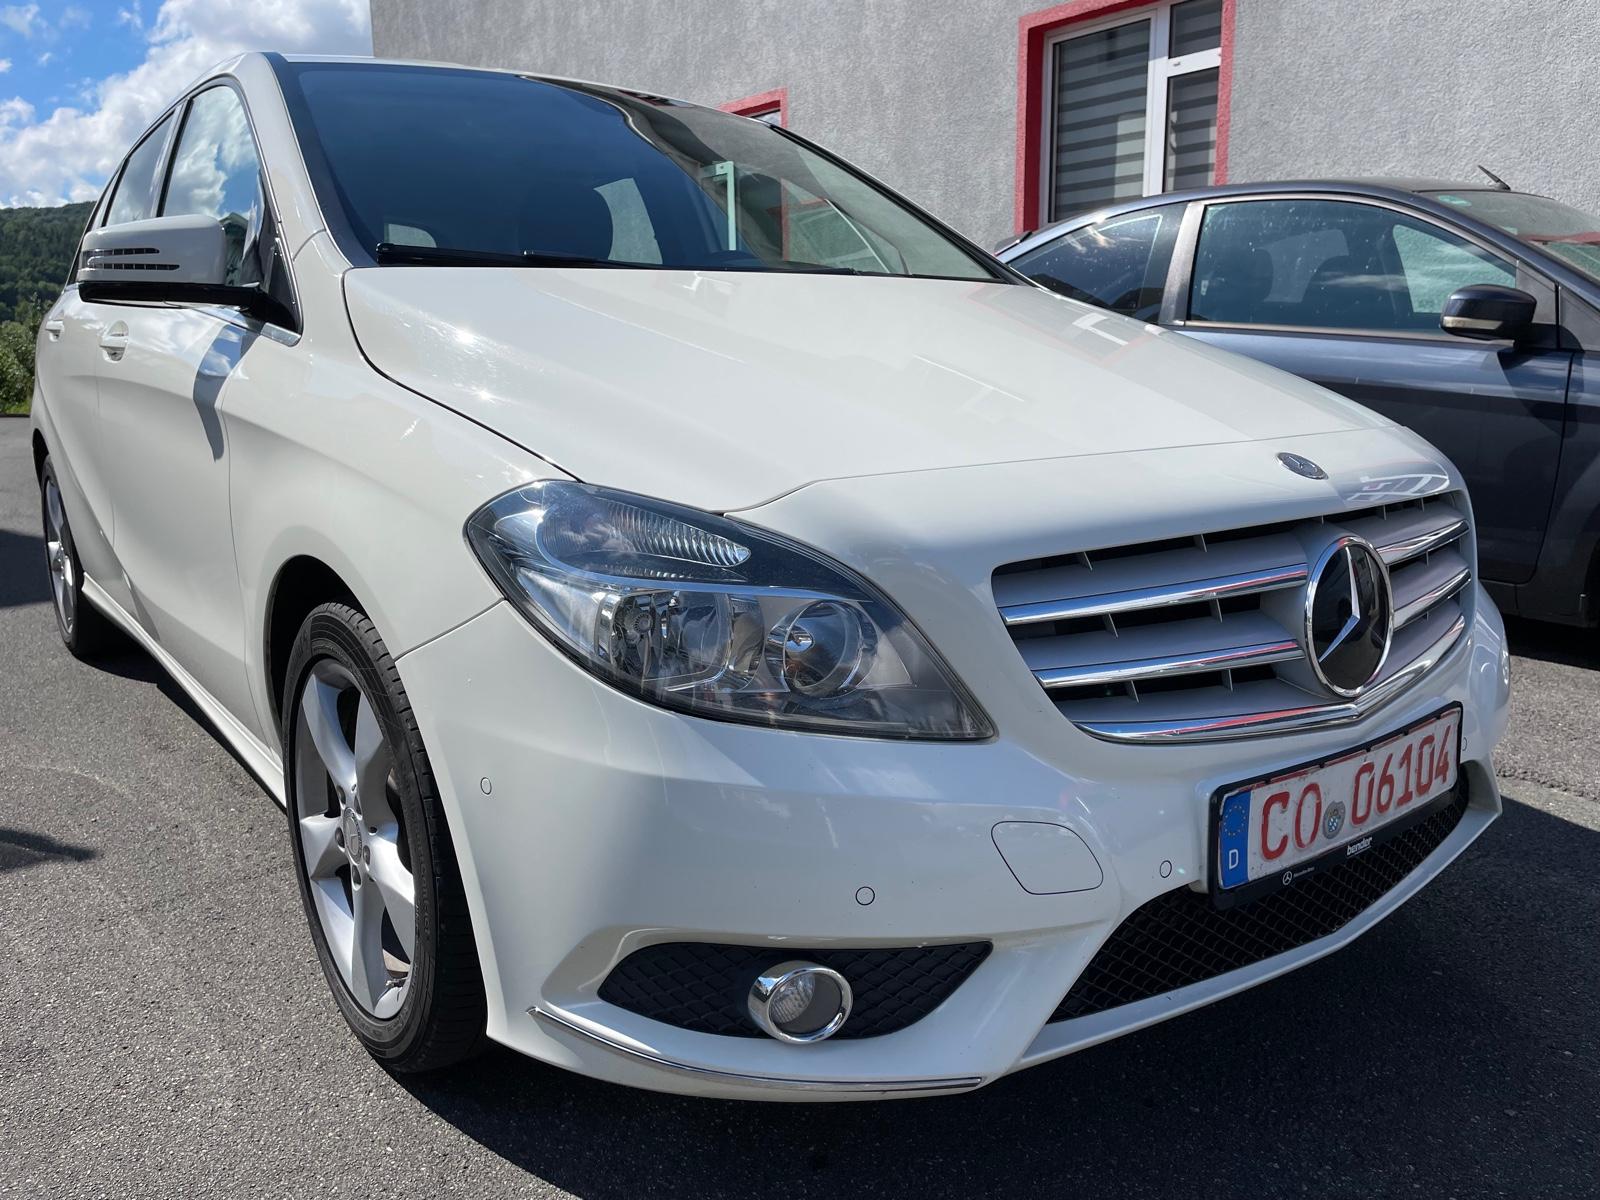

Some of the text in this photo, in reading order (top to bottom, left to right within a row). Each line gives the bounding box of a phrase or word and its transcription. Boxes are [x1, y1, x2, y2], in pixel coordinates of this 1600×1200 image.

[1261, 725, 1451, 860] CO 06104
[1228, 849, 1239, 870] D
